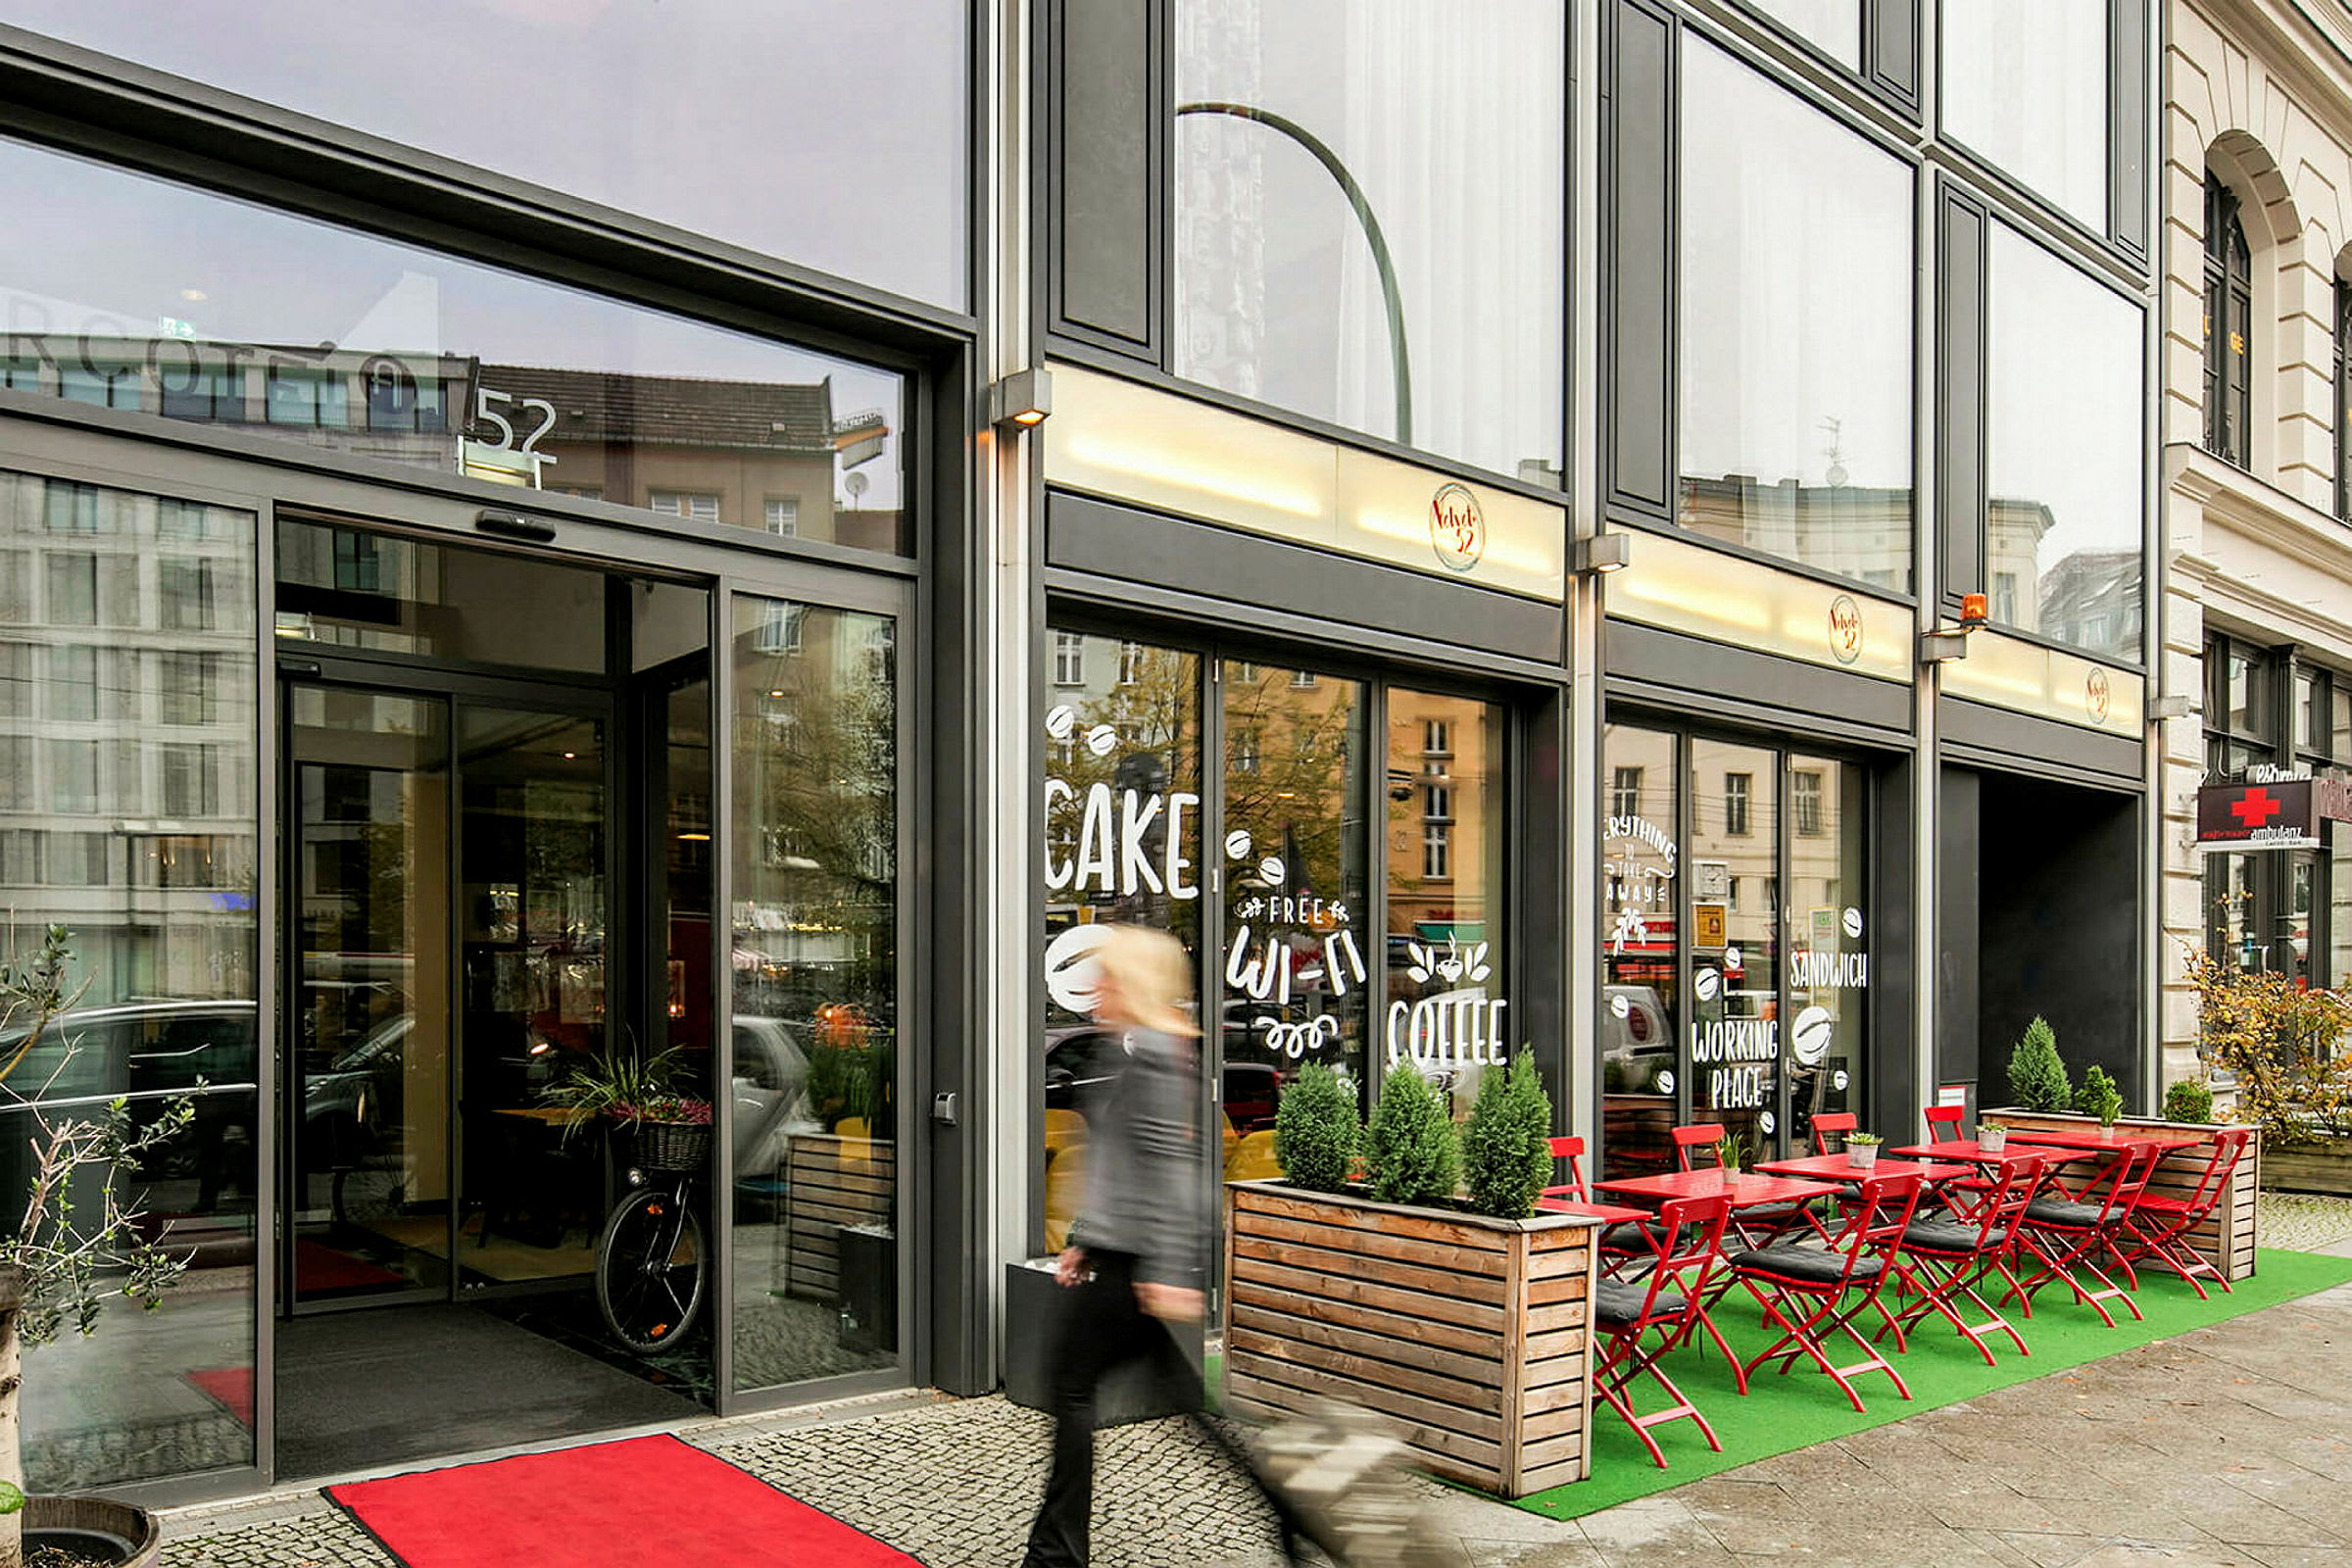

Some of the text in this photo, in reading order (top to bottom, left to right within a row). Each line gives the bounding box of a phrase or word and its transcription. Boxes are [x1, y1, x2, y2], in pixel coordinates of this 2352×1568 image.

[476, 387, 558, 465] 52
[1044, 778, 1200, 900] CAKE
[2250, 824, 2303, 841] ambulanz
[1269, 896, 1325, 924] FREE
[1605, 882, 1653, 903] AWAY
[1225, 924, 1367, 1006] WI-FI
[1789, 950, 1868, 988] SANDWICH
[1387, 999, 1508, 1069] COFFEE
[1690, 1019, 1779, 1063] WORKING
[1710, 1065, 1763, 1109] PLACE
